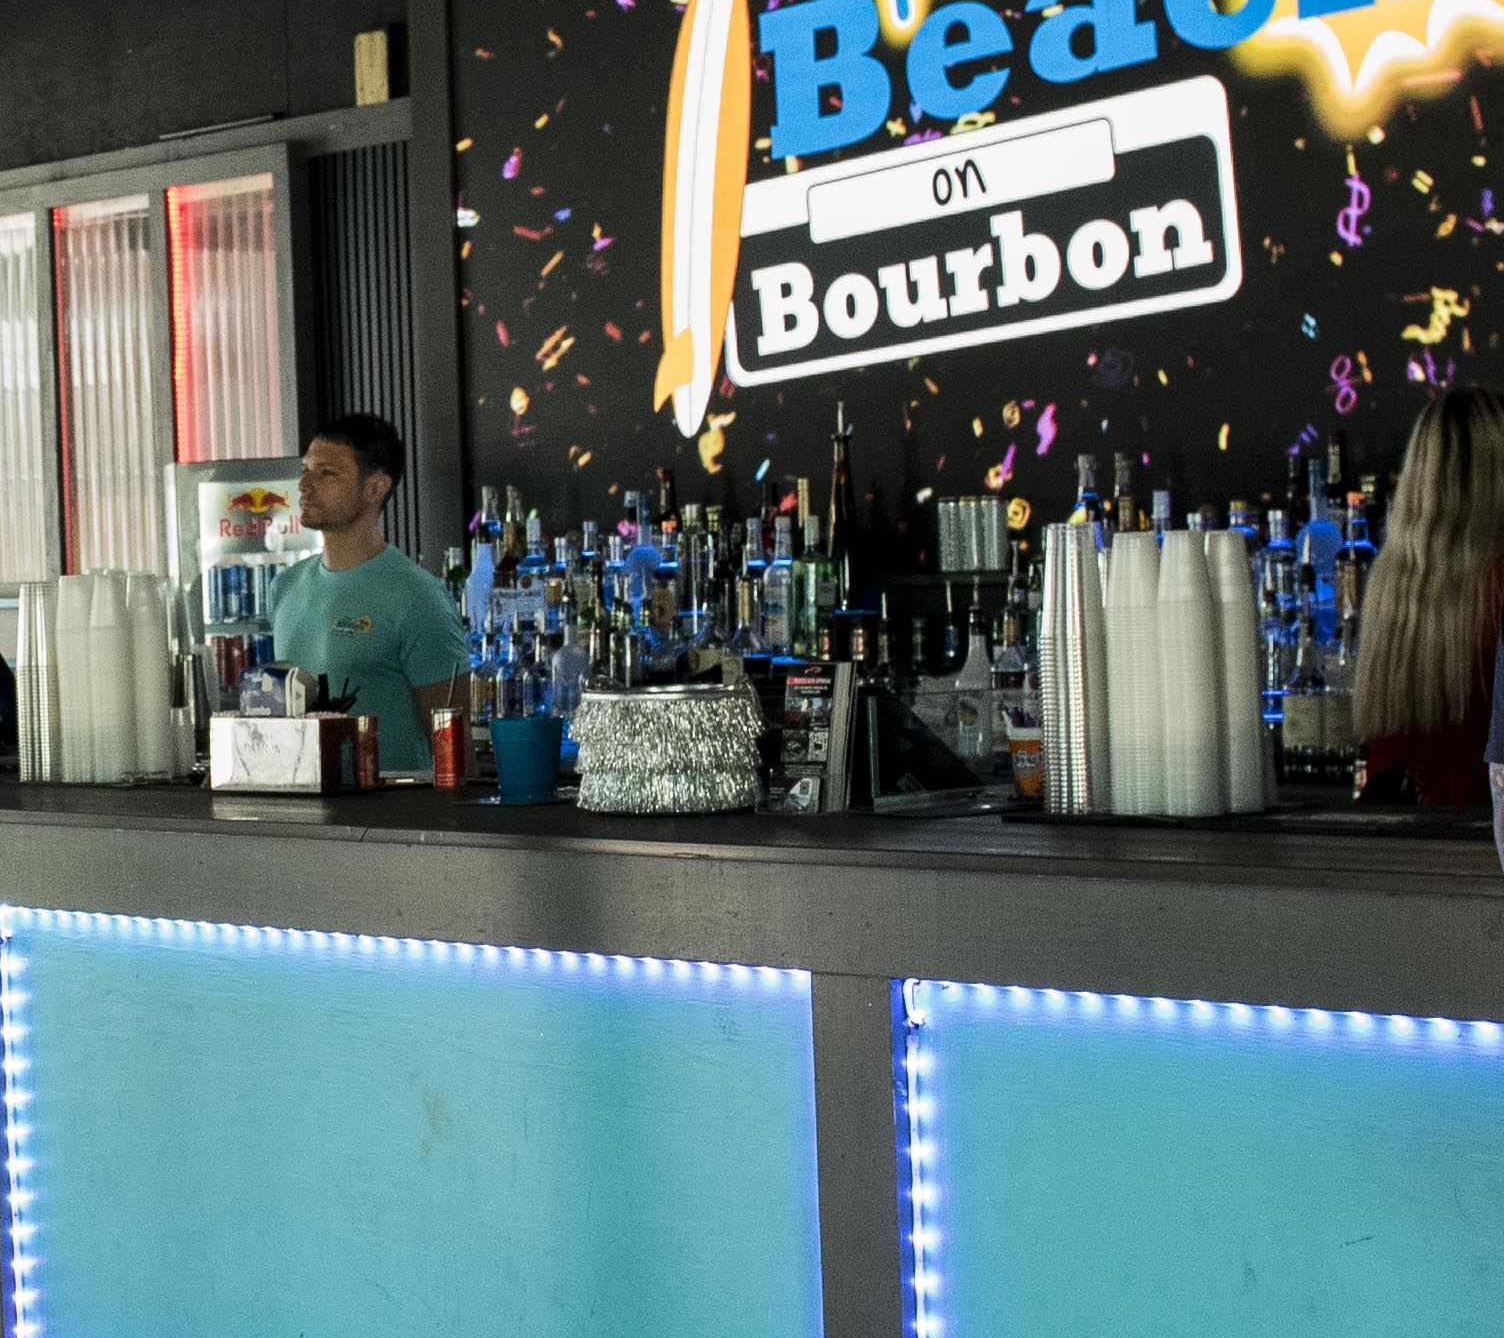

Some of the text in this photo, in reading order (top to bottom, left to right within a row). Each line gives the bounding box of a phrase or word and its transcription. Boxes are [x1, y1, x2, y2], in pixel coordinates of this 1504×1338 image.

[932, 154, 987, 207] on
[751, 197, 1212, 356] Bourbon
[219, 517, 260, 538] Red
